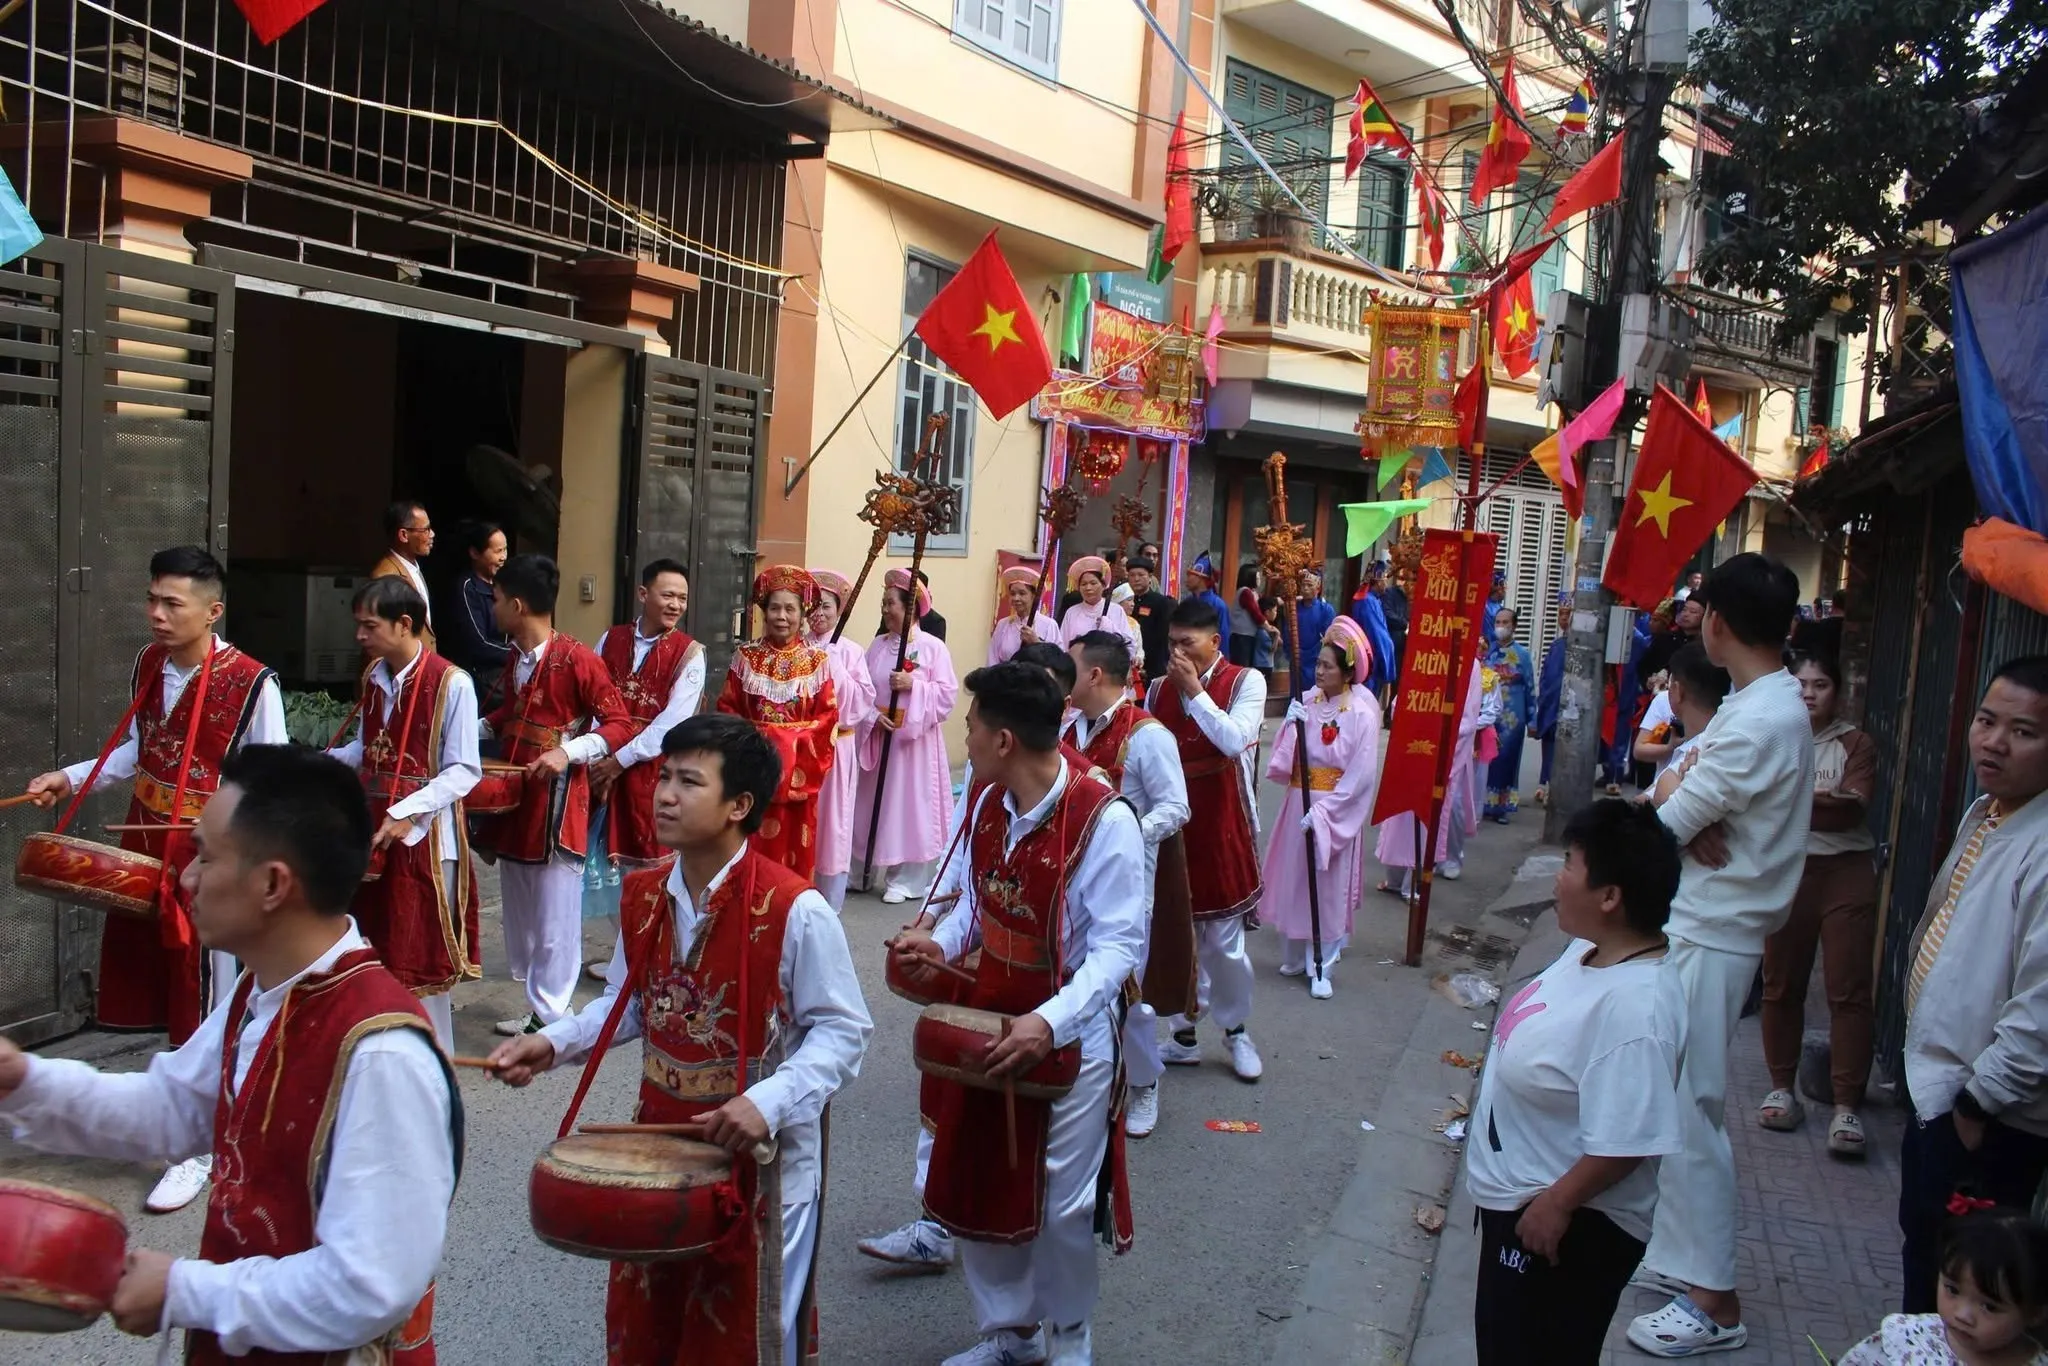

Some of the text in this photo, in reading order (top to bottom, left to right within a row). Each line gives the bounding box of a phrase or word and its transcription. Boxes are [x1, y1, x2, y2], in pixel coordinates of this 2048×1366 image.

[1119, 299, 1143, 318] NGÕ
[1059, 381, 1098, 411] Chúc
[1498, 1246, 1531, 1274] ABC
